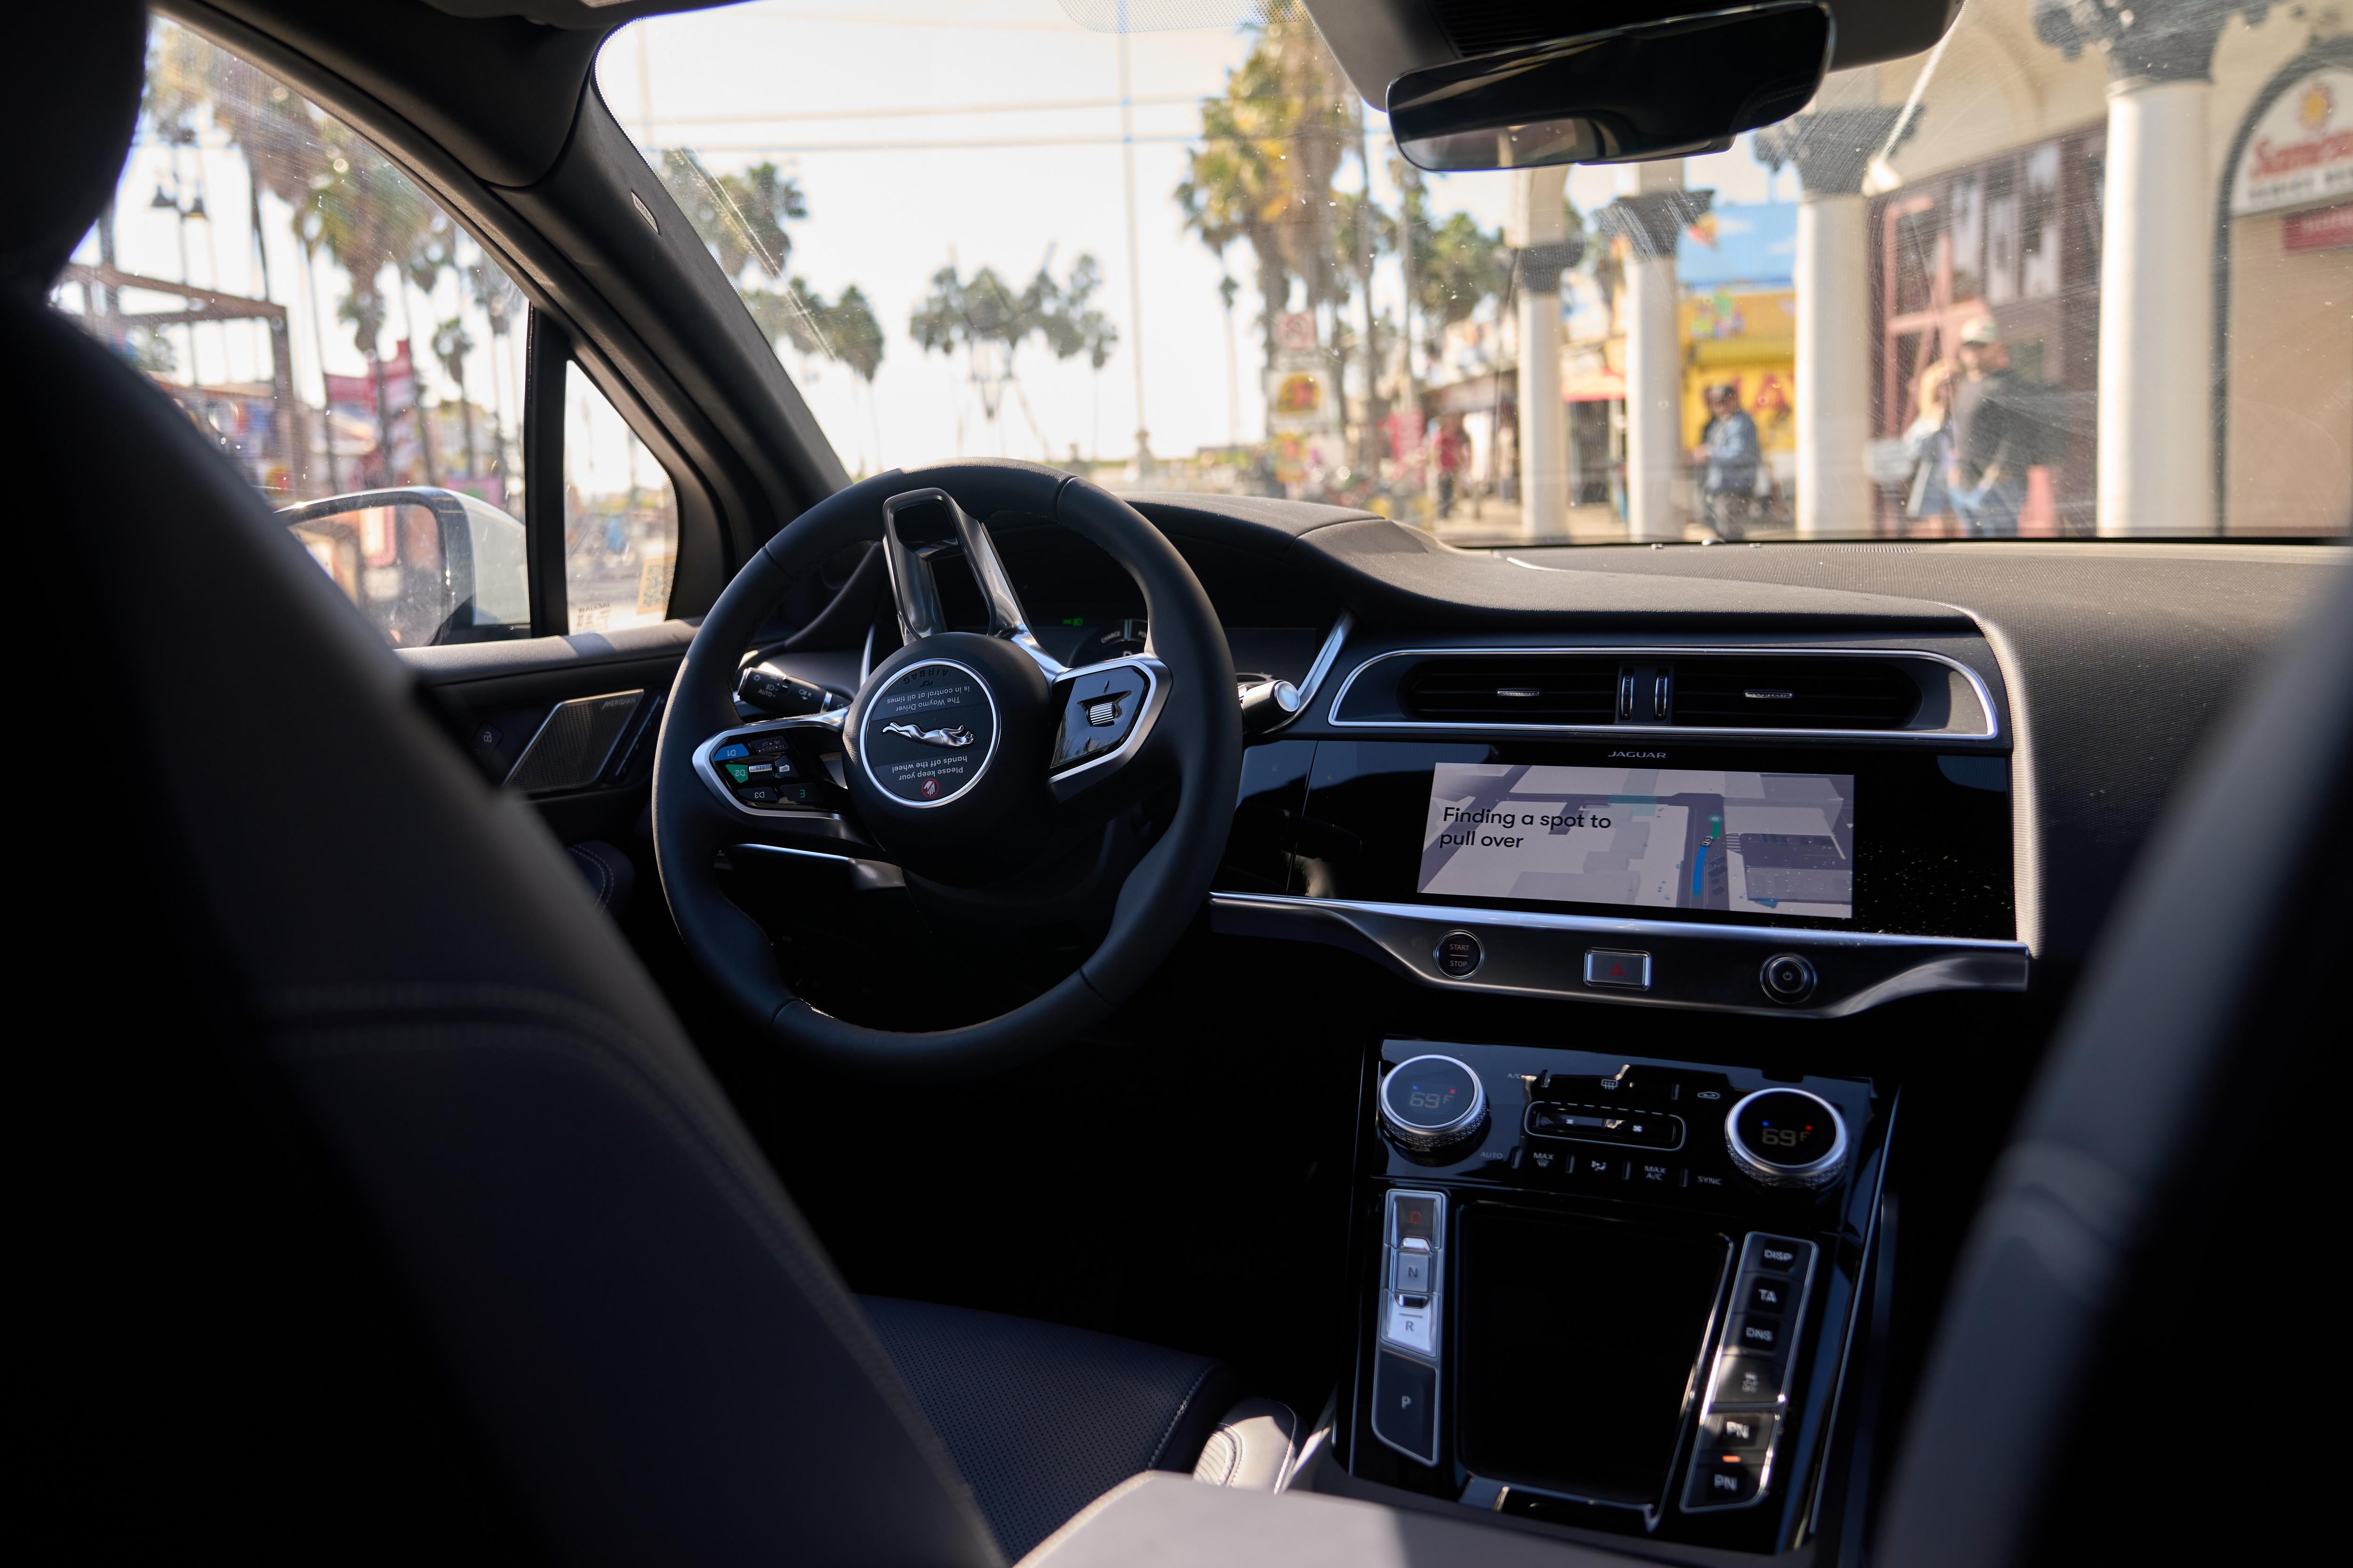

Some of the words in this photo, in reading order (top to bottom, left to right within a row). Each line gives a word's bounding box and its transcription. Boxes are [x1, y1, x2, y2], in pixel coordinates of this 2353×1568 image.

[1101, 630, 1121, 644] CHARGE
[903, 669, 949, 685] AIRBAG
[757, 688, 772, 697] AUTO
[928, 689, 953, 698] control
[603, 697, 636, 709] MERIDIAN
[887, 696, 905, 704] times
[918, 699, 945, 708] Waymo
[896, 704, 916, 712] Driver
[892, 763, 913, 773] wheel
[917, 768, 936, 777] keep
[937, 766, 963, 774] Please
[898, 771, 916, 780] your
[800, 789, 805, 798] E
[1443, 807, 1515, 829] Finding
[1521, 814, 1534, 825] a
[1540, 813, 1584, 830] spot
[1590, 814, 1611, 828] to
[1439, 831, 1476, 848] pull
[1481, 836, 1524, 848] over
[1410, 1091, 1439, 1108] 69
[1761, 1128, 1797, 1146] 69
[1644, 1165, 1666, 1173] MAX
[1697, 1176, 1722, 1185] SYNC
[1409, 1210, 1421, 1224] D
[1764, 1249, 1793, 1262] DISP
[1408, 1266, 1418, 1278] N
[1758, 1288, 1777, 1303] TA
[1405, 1320, 1414, 1331] R
[1745, 1327, 1774, 1341] DNS
[1401, 1396, 1411, 1409] P
